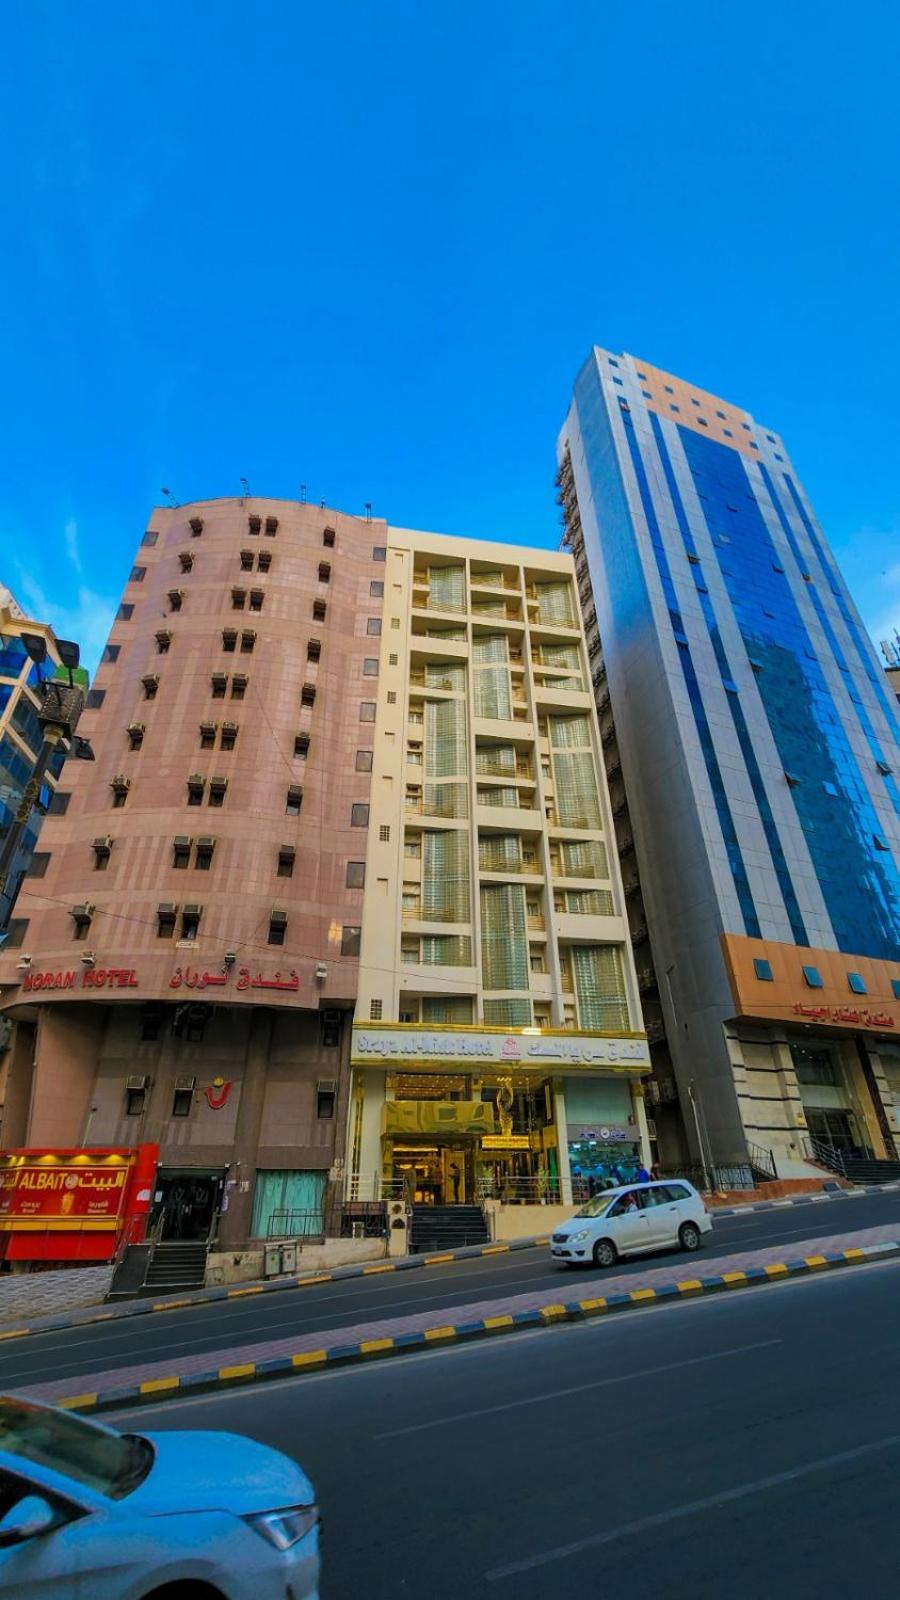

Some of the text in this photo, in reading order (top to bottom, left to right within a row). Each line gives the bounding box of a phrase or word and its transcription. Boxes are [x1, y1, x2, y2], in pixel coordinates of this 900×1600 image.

[22, 969, 138, 992] NORAN HOTEL
[235, 968, 299, 991] فندق
[19, 1172, 68, 1190] ALBAIT
[78, 1171, 125, 1191] البيت
